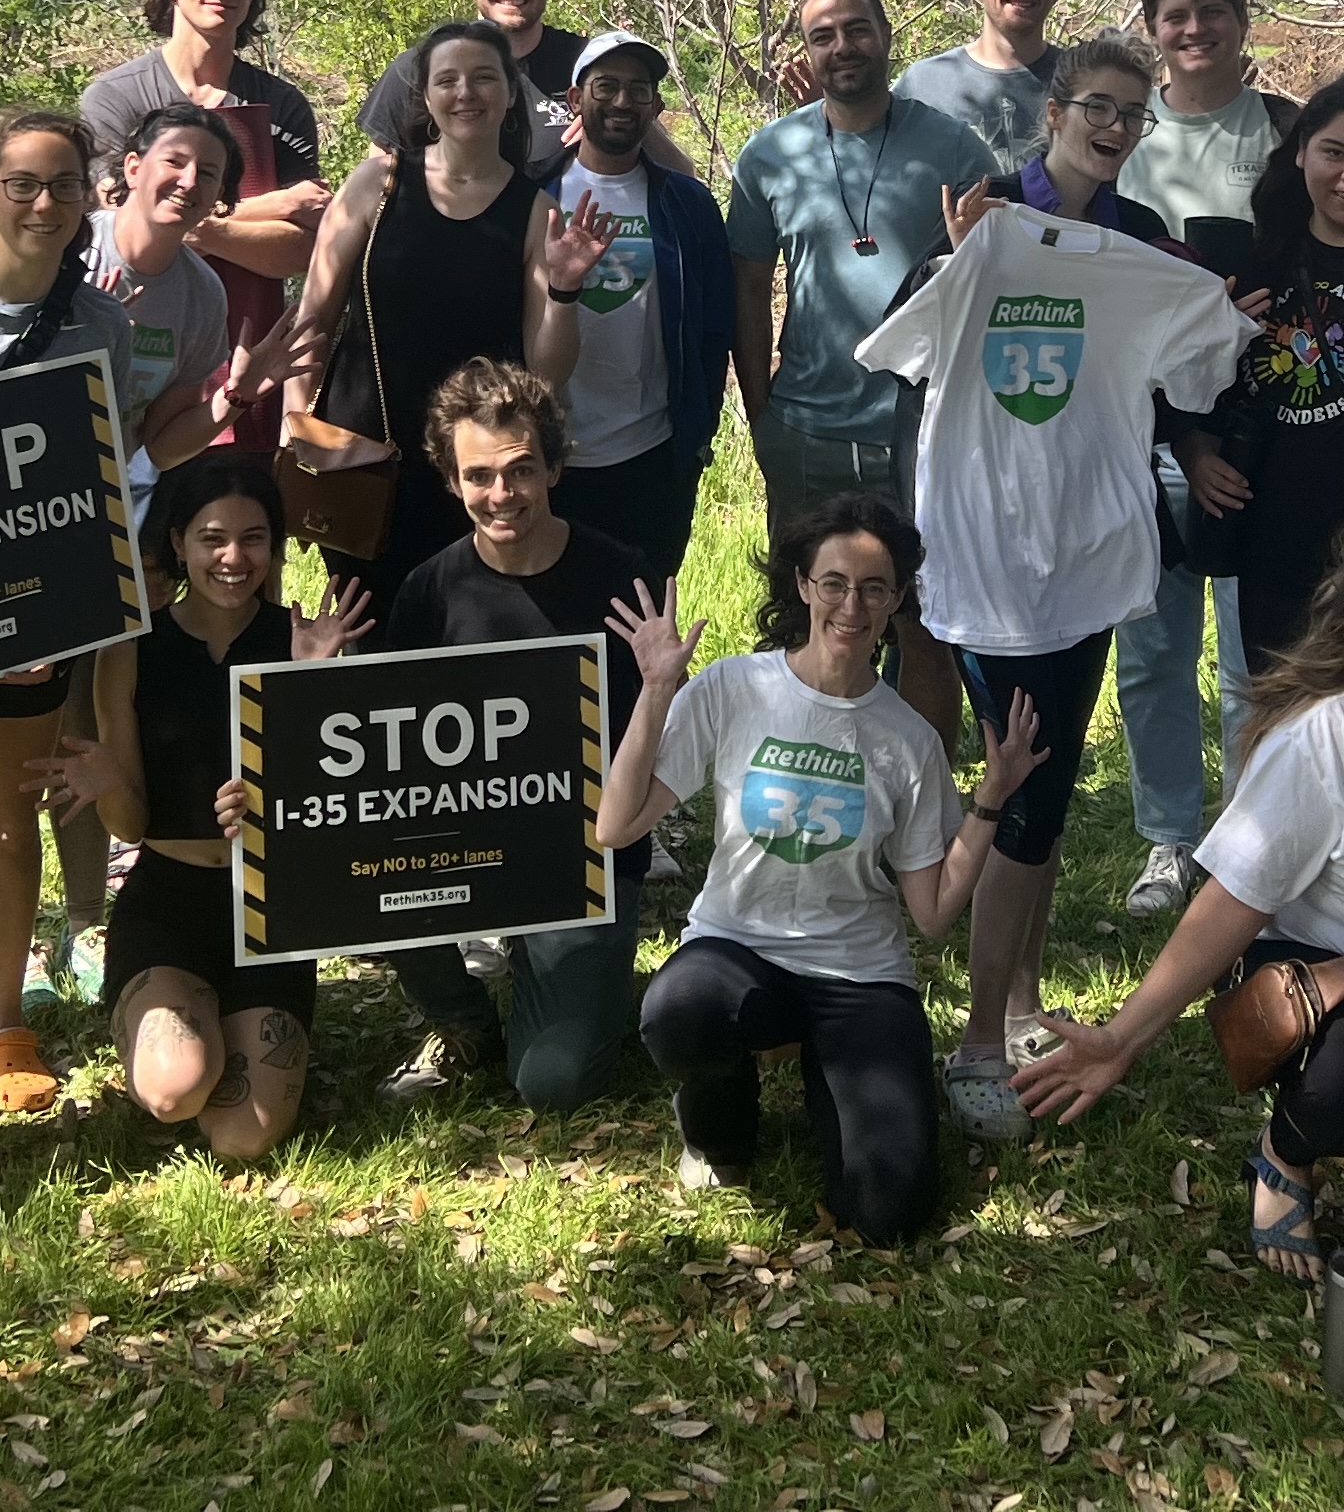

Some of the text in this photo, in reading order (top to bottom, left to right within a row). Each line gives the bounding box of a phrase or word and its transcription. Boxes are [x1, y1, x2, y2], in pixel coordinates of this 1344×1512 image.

[996, 300, 1081, 324] Rethink
[1002, 343, 1068, 397] 35
[4, 576, 42, 596] lanes
[319, 697, 530, 778] STOP
[760, 744, 862, 779] Rethink
[275, 770, 572, 830] I-35 EXPANSION
[754, 786, 846, 846] 35
[351, 848, 504, 877] Say NO to 20+ lanes
[383, 888, 467, 908] Rethink35.org
